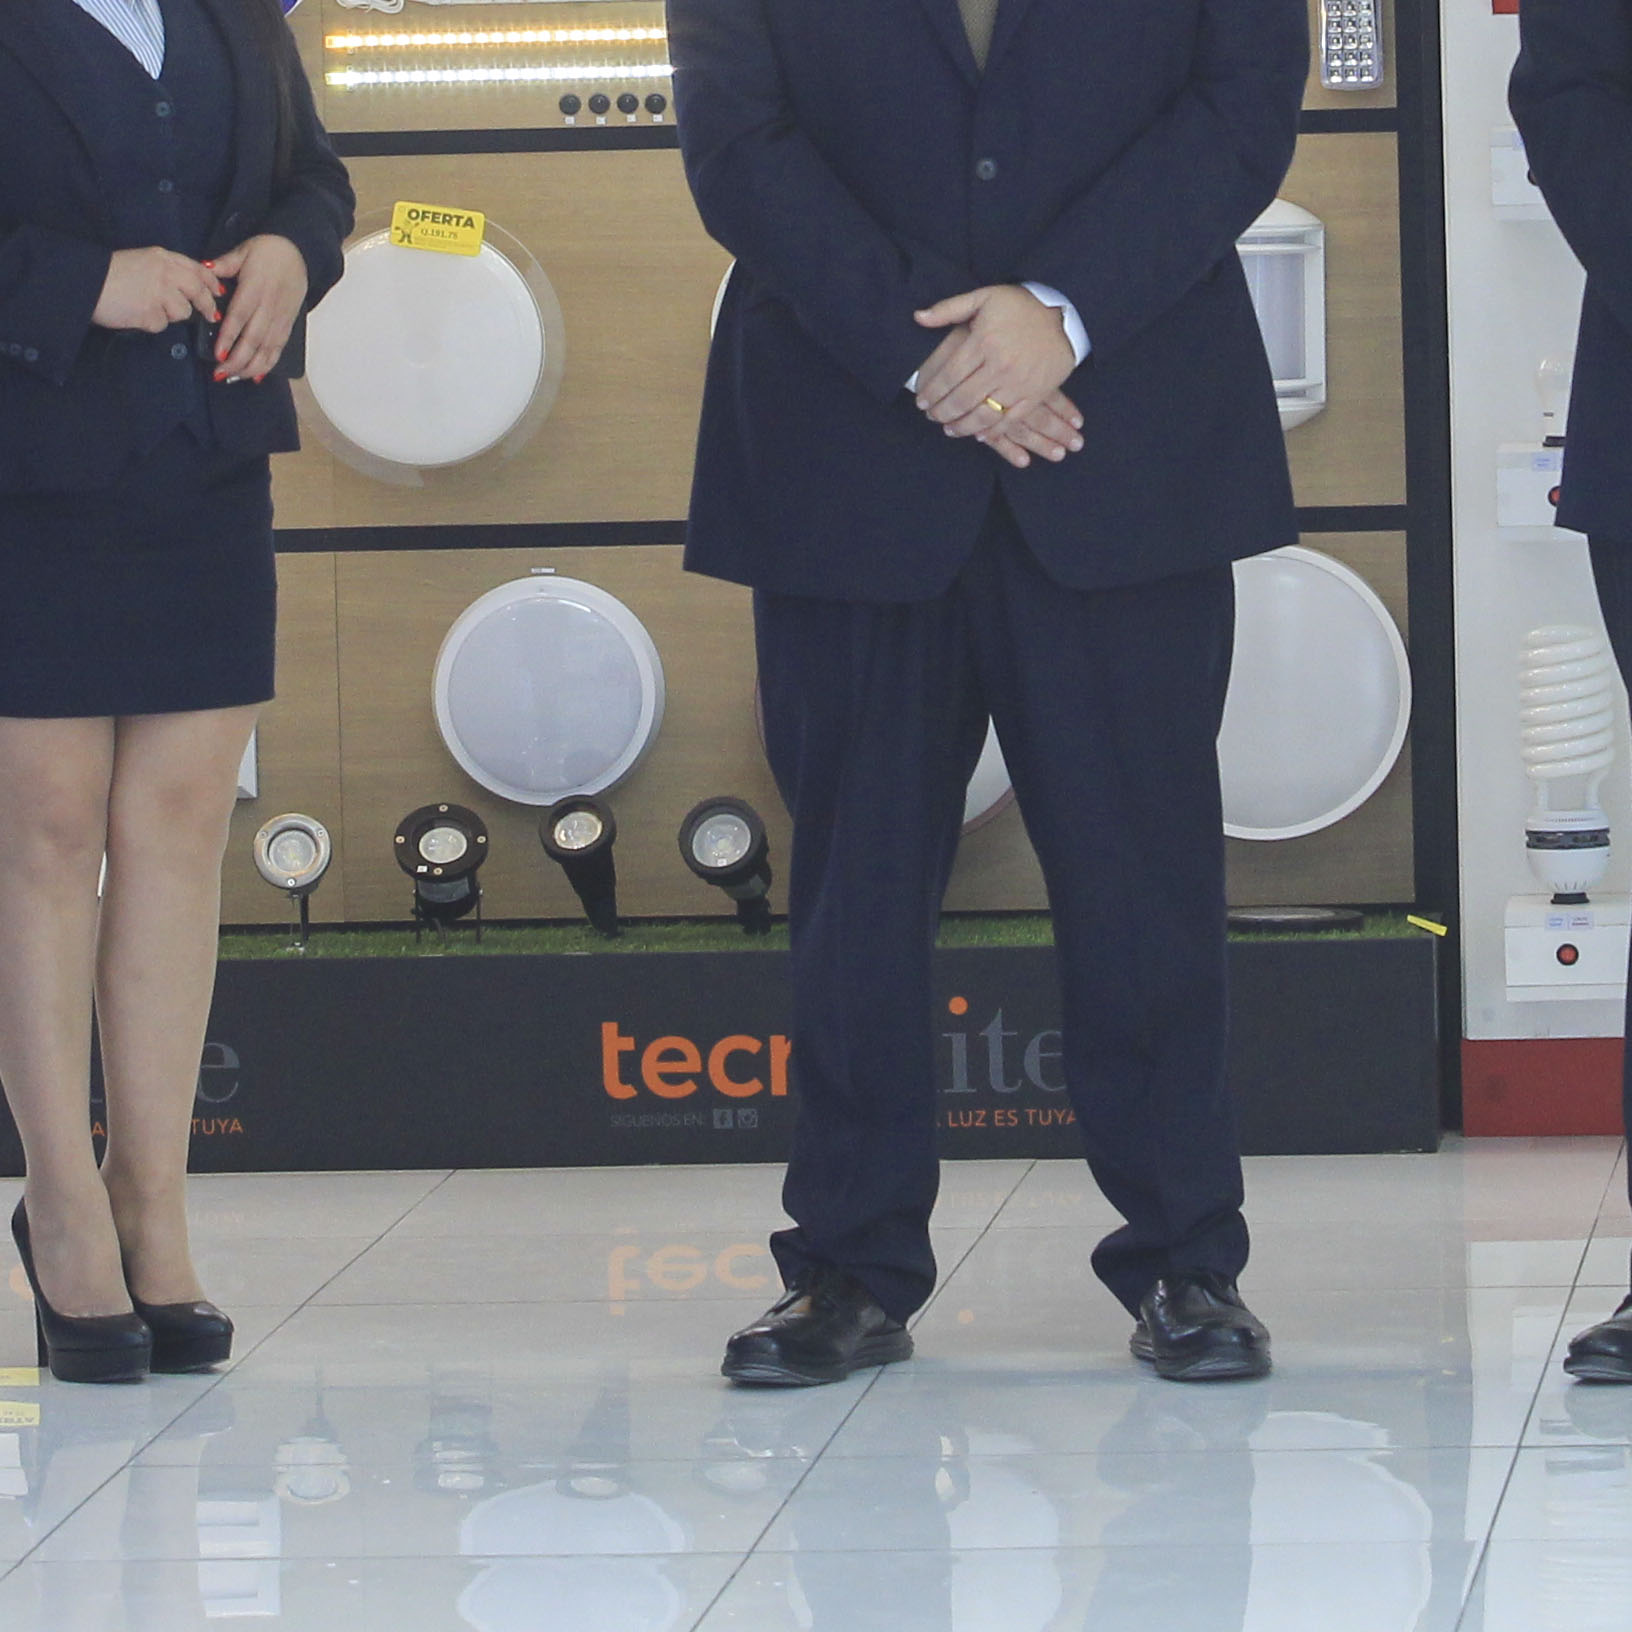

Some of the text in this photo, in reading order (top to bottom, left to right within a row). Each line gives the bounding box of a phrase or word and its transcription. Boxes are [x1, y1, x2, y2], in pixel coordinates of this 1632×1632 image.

[408, 208, 476, 229] OFERTA
[190, 1117, 244, 1135] TUYA
[947, 1108, 1077, 1128] LUZ ES TUYA
